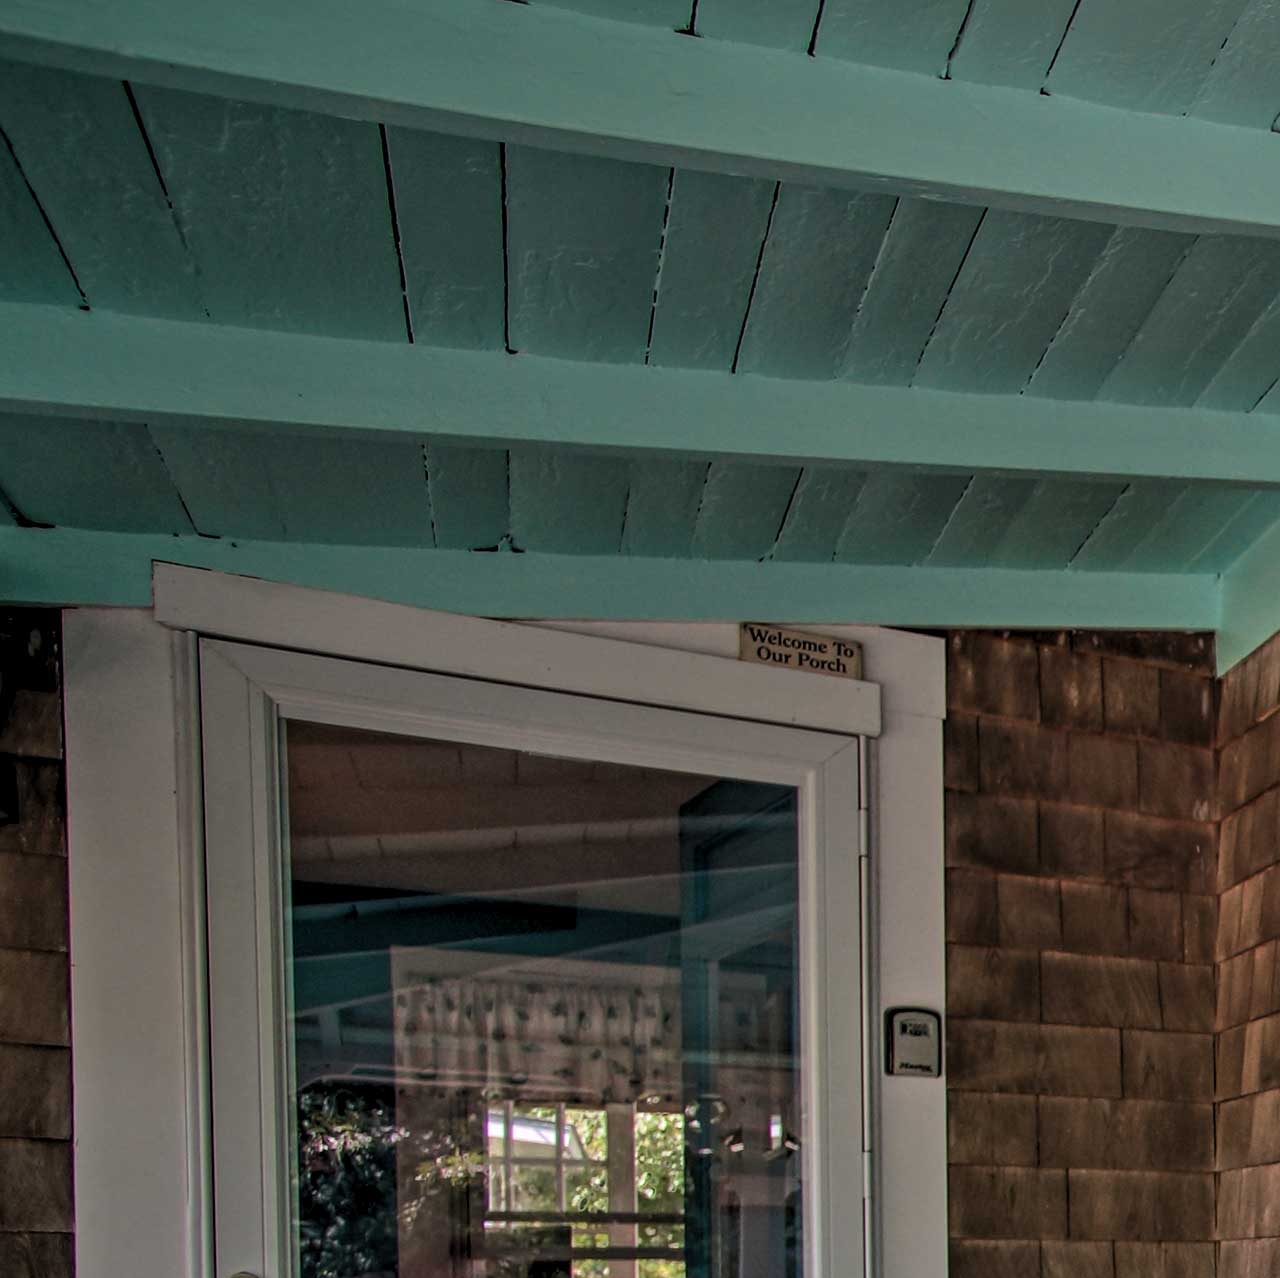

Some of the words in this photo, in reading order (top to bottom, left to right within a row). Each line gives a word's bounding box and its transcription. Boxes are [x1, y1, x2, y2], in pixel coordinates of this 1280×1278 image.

[749, 627, 828, 654] Welcome
[833, 641, 854, 659] To
[756, 645, 792, 665] Our
[797, 652, 847, 674] Porch
